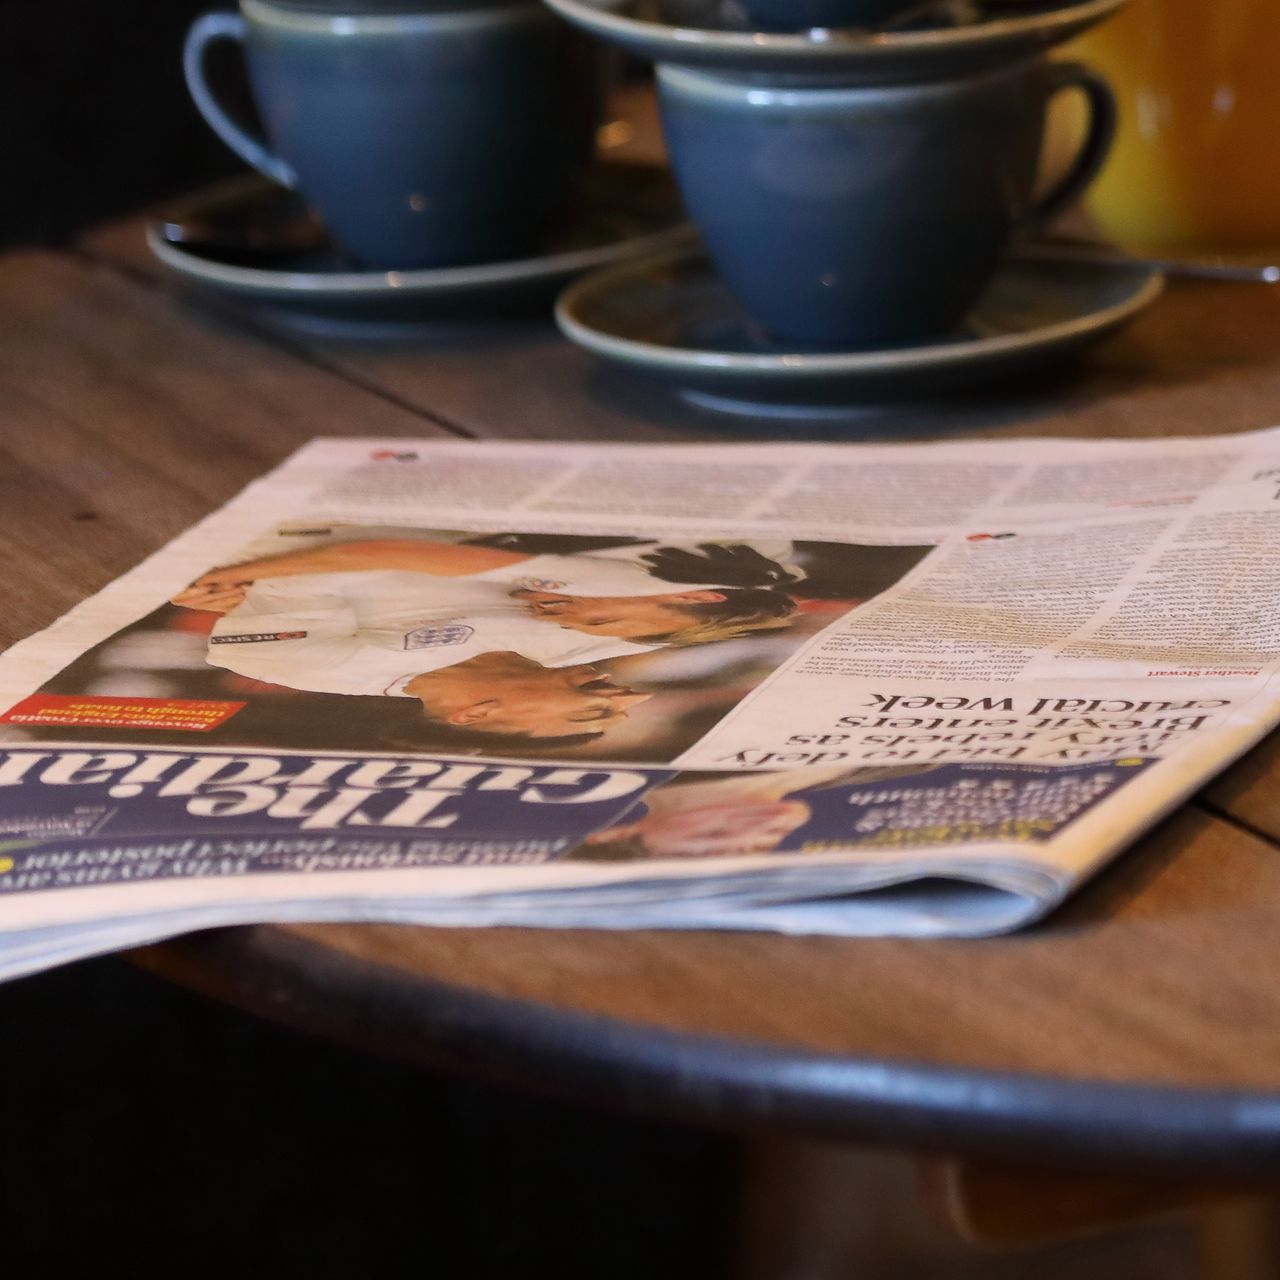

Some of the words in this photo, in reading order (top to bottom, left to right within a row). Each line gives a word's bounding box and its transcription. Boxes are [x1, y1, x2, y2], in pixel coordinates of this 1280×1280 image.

[861, 694, 1016, 714] week
[1027, 698, 1235, 716] crucial
[835, 716, 1020, 731] enters
[1034, 716, 1208, 733] Brexit
[785, 735, 852, 746] as
[861, 733, 1037, 748] rebels
[1049, 732, 1180, 748] Tory
[714, 749, 849, 767] defy
[863, 750, 919, 761] to
[937, 746, 1028, 762] bid
[187, 784, 462, 829] The
